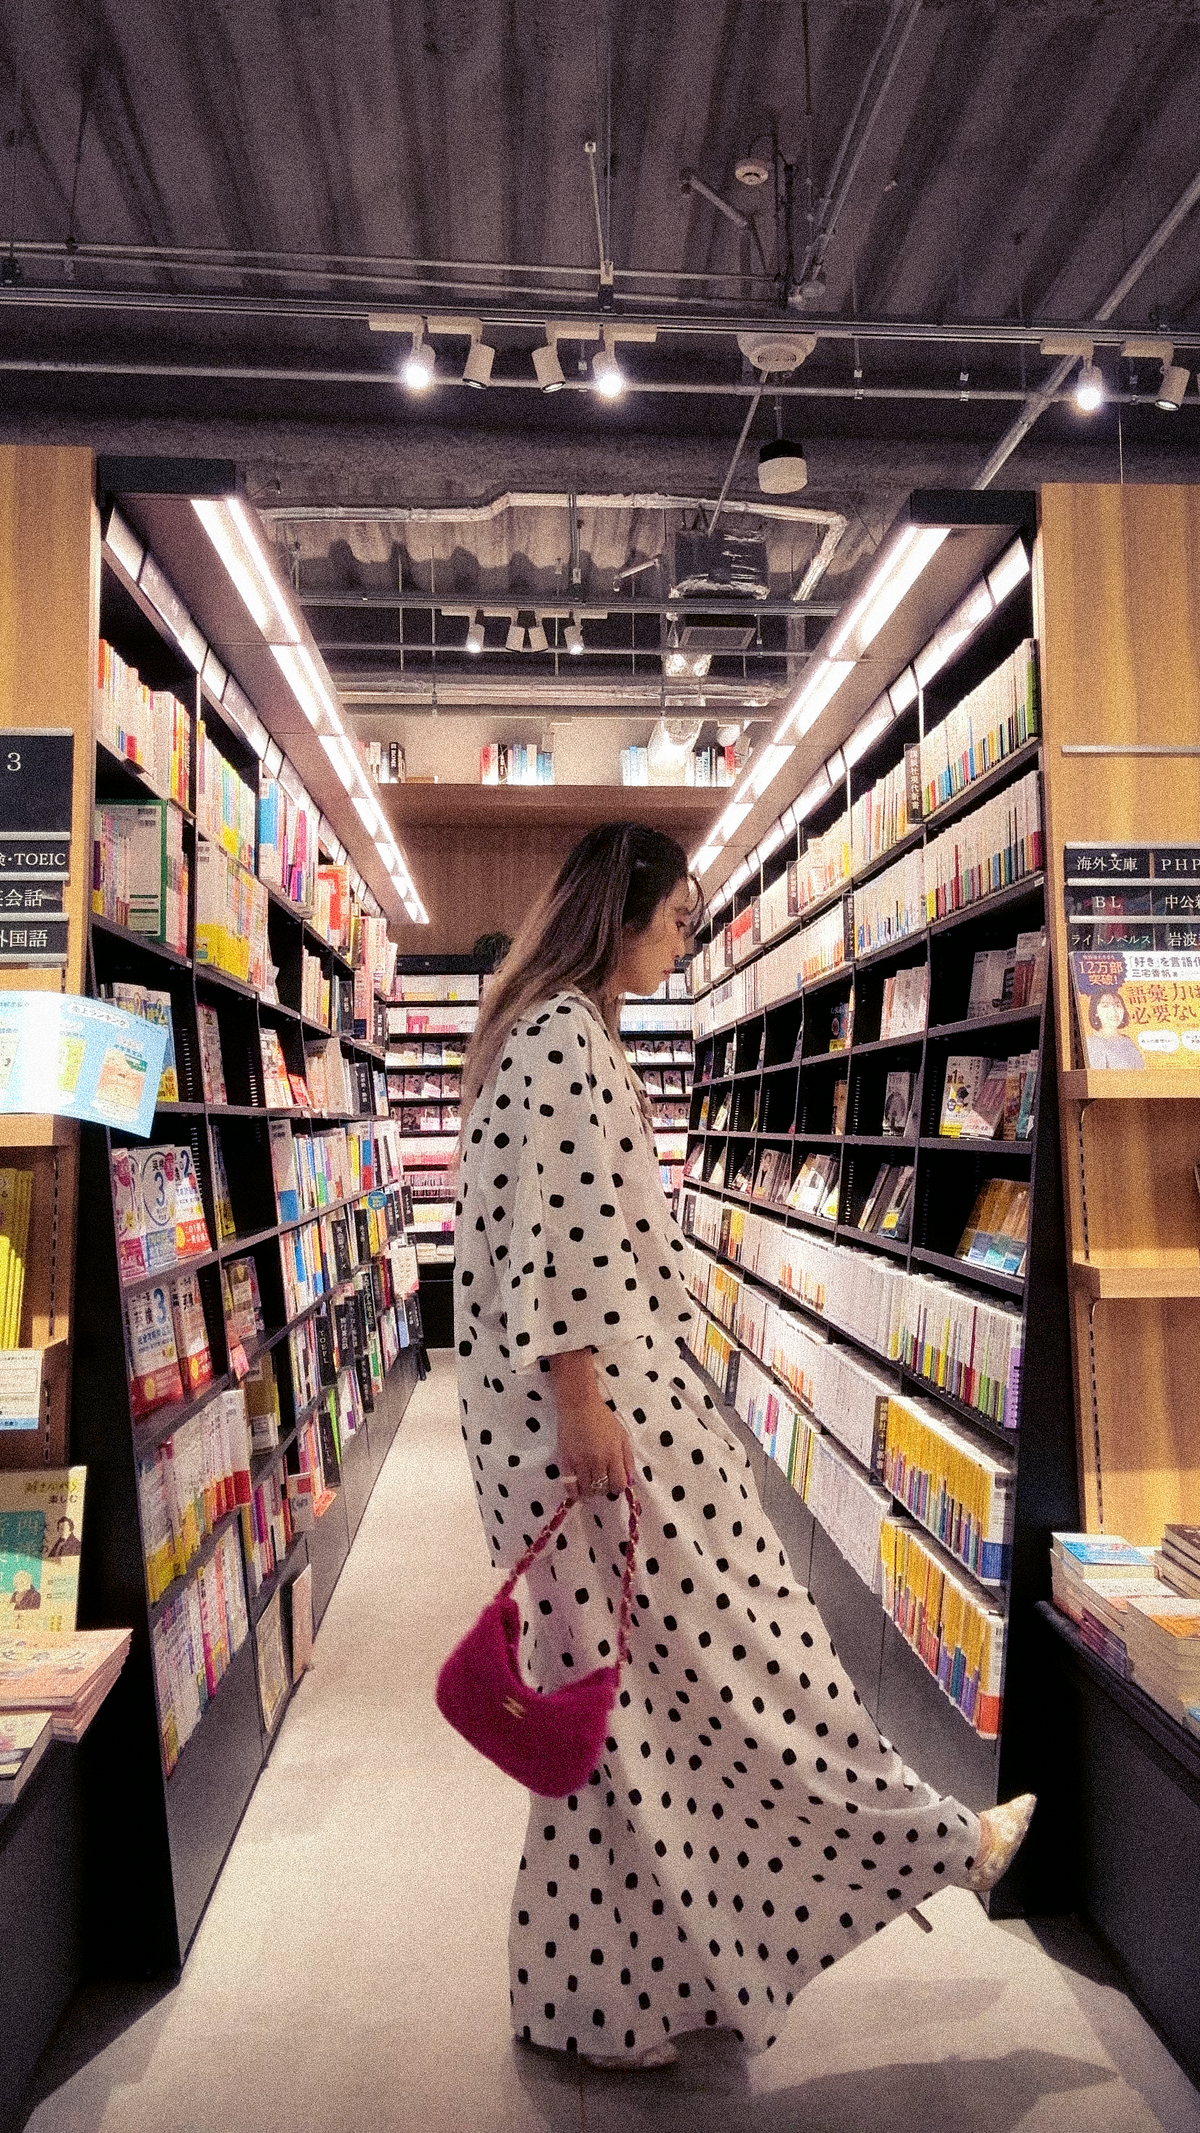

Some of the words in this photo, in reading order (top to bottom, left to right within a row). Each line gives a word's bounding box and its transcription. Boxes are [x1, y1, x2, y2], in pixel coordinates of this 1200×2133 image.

[7, 752, 22, 771] 3
[1077, 856, 1138, 872] 海外文庫
[0, 888, 42, 907] 会話
[1071, 934, 1151, 946] ライトノベルス
[1168, 931, 1200, 947] 岩波
[1079, 961, 1123, 975] 12万部
[154, 1171, 166, 1207] 3
[153, 1288, 166, 1324] 3
[319, 1329, 329, 1364] TOEFL
